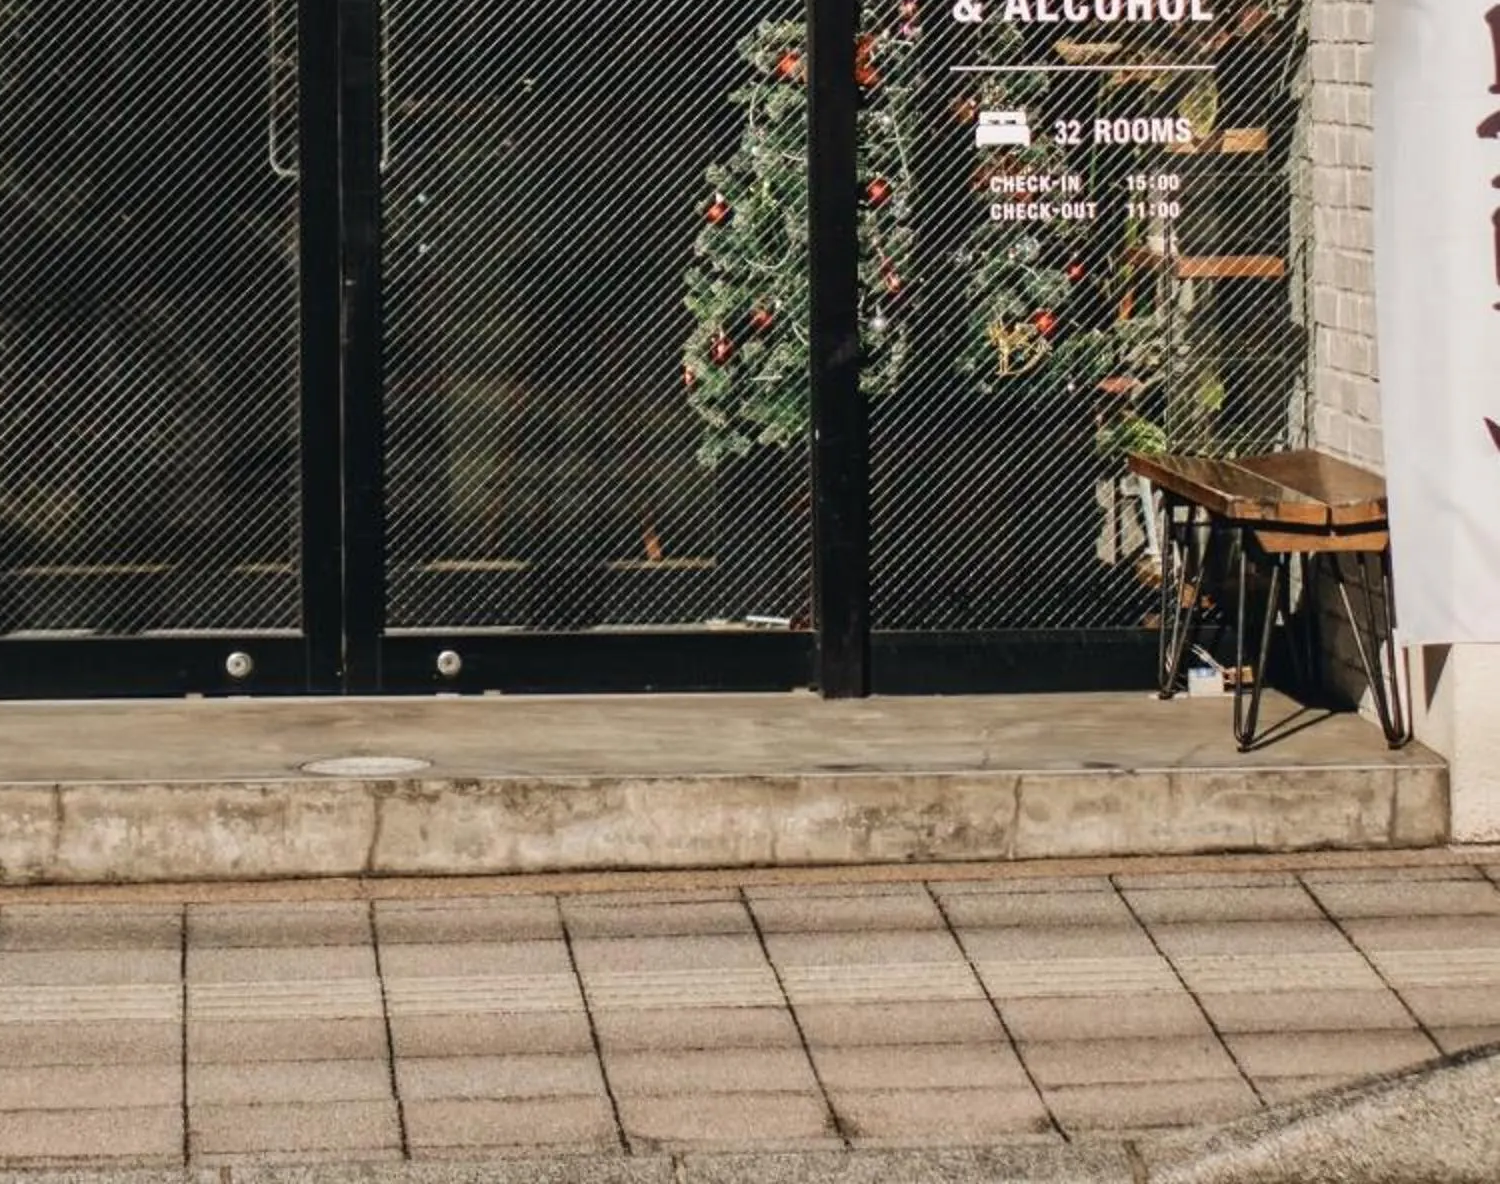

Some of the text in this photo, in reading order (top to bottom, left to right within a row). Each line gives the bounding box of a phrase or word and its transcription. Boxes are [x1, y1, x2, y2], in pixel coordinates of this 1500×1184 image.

[1054, 118, 1192, 145] 32 ROOMS
[989, 173, 1181, 193] CHECK-IN 15:00
[989, 201, 1181, 220] CHECK-OUT 11:00
